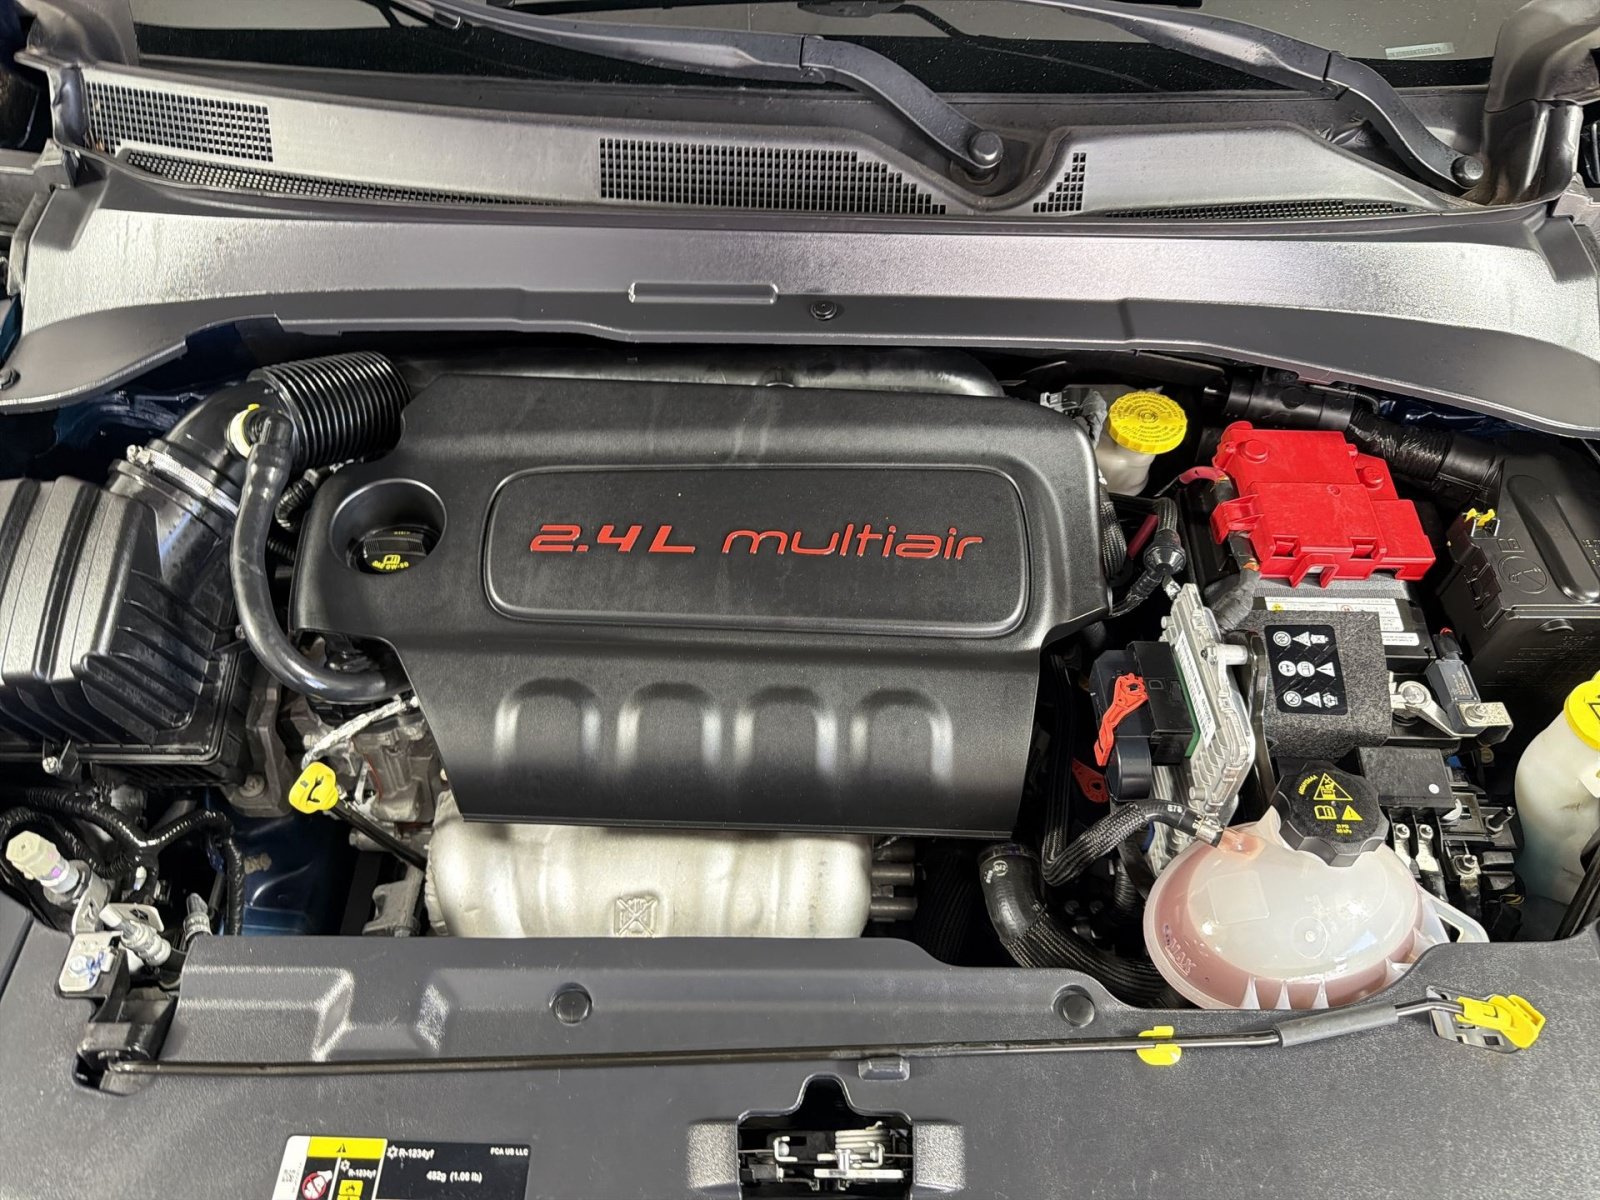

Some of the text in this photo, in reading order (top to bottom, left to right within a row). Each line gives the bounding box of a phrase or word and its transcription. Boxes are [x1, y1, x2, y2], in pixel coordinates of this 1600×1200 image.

[721, 524, 984, 560] multiair
[490, 1147, 505, 1156] FCA
[515, 1148, 529, 1156] LLC
